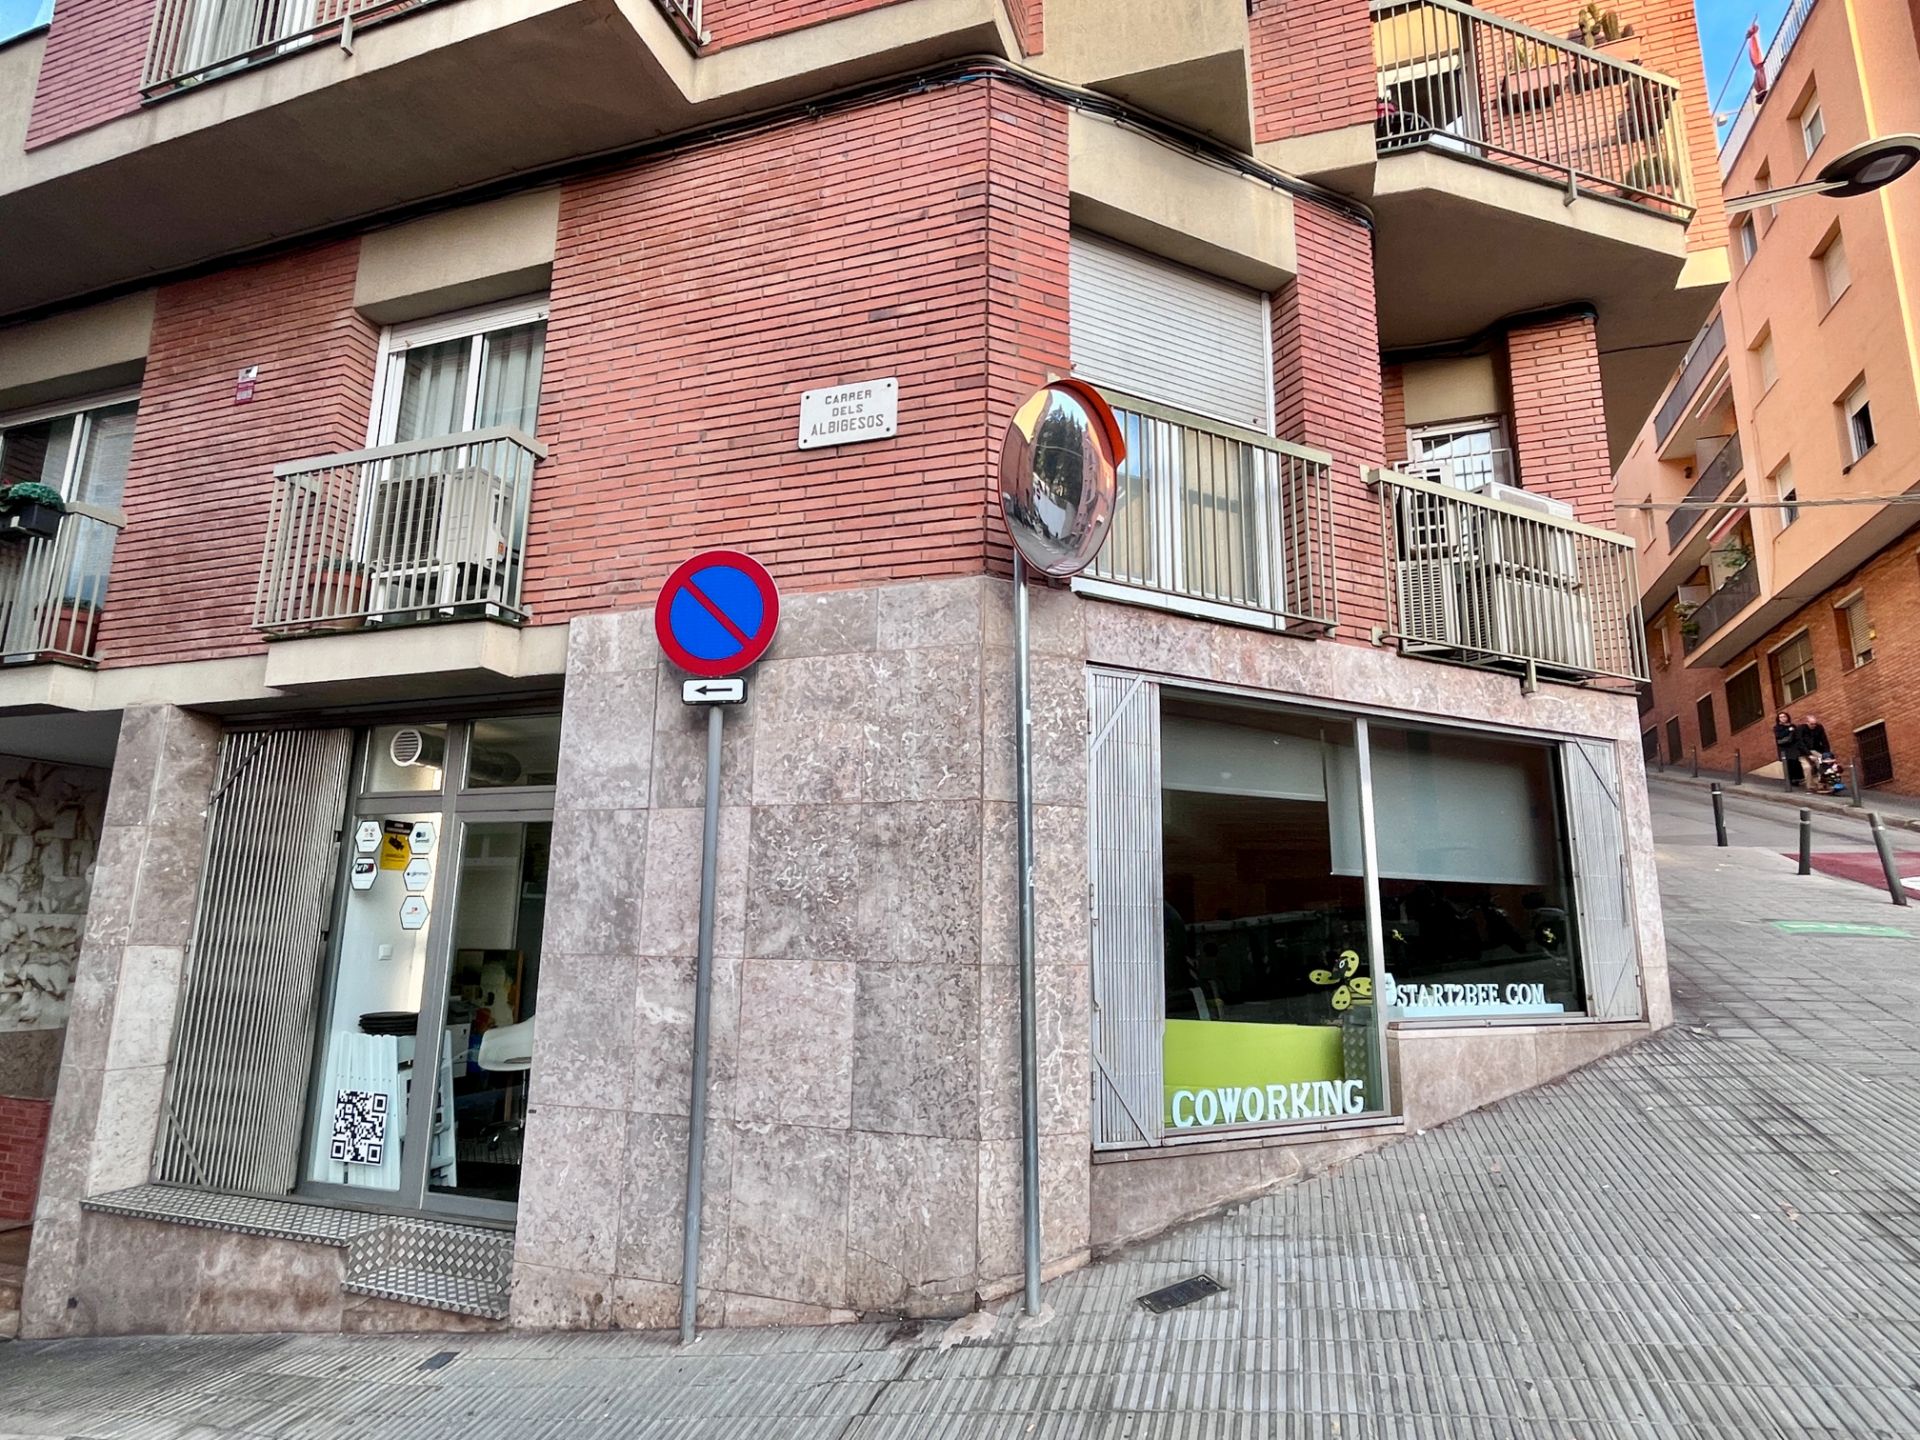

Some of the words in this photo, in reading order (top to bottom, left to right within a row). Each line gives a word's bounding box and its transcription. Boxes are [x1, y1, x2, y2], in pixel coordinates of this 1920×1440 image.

[825, 389, 872, 405] CARRER
[832, 404, 863, 417] DELS
[811, 414, 884, 436] ALBIGESOS
[1172, 1079, 1365, 1129] COWORKING
